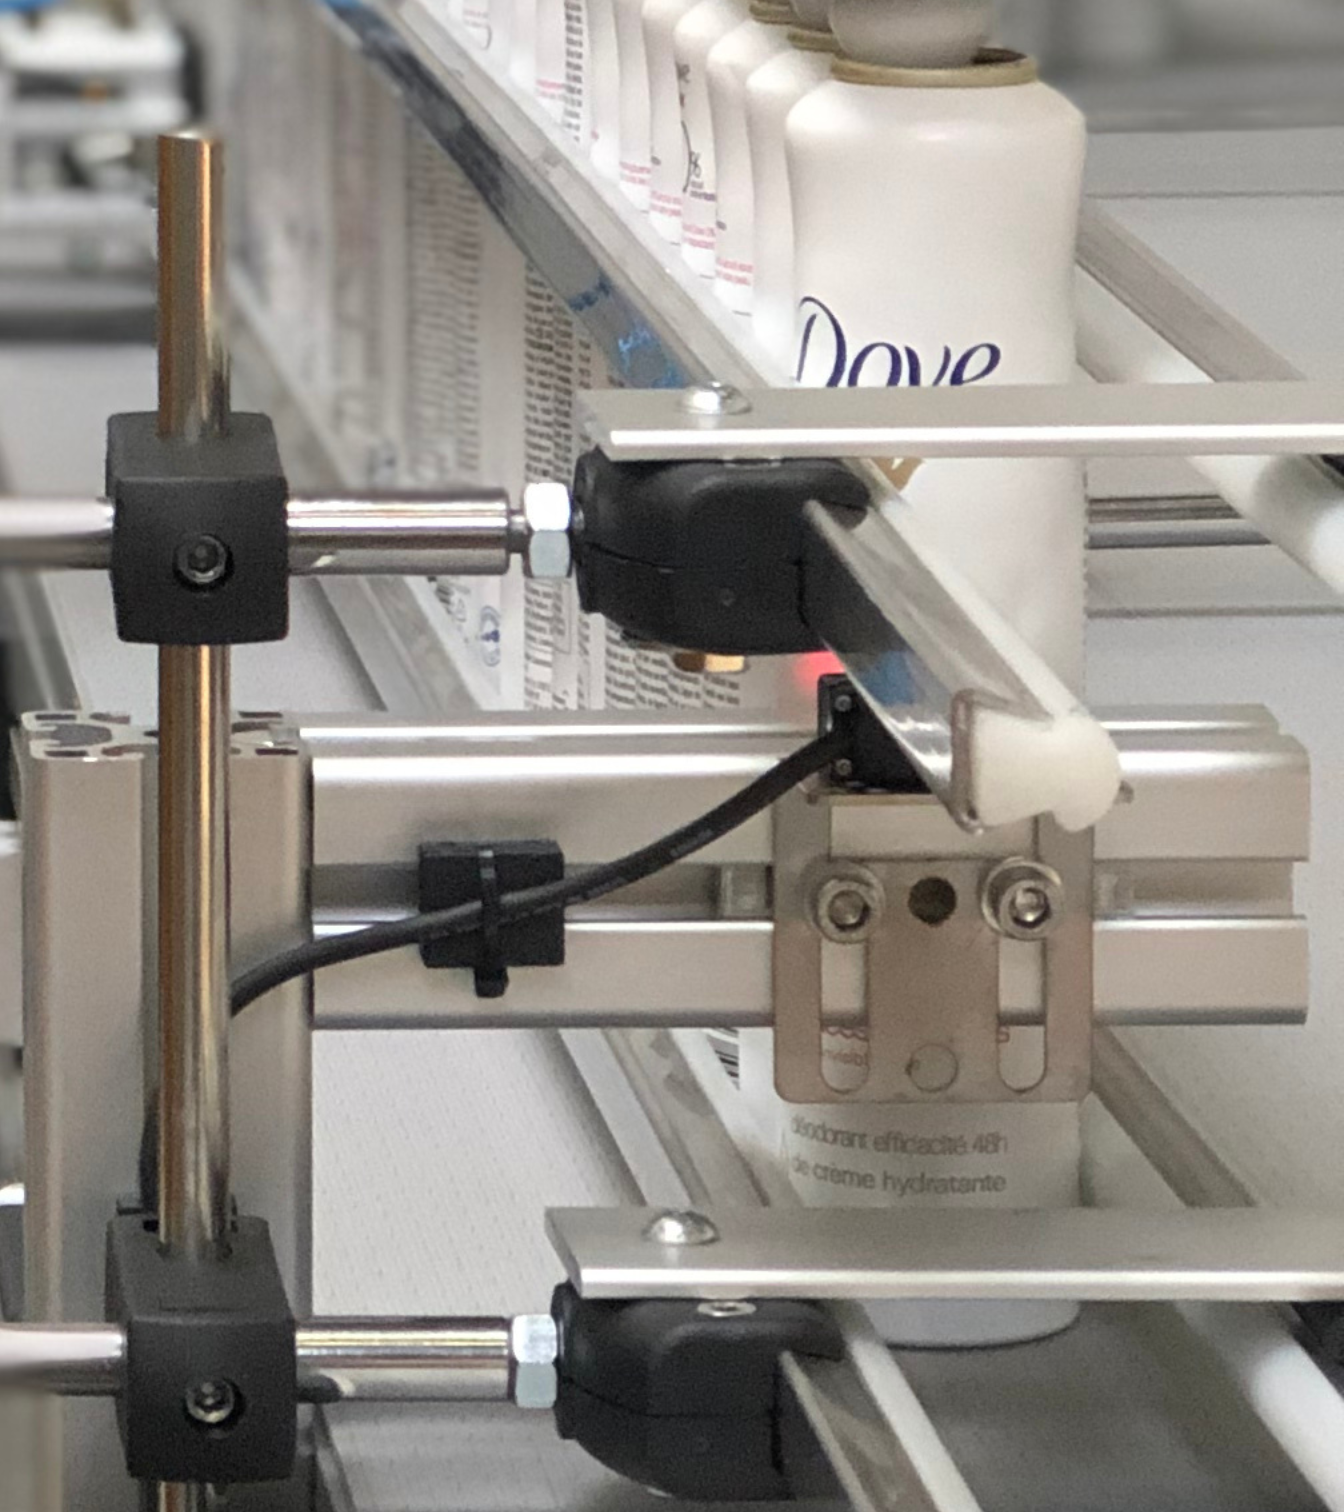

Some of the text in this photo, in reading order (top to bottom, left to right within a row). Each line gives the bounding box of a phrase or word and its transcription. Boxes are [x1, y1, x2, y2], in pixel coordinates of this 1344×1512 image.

[796, 295, 1002, 388] Dove
[813, 1162, 876, 1190] crème
[883, 1170, 1007, 1198] hydratante
